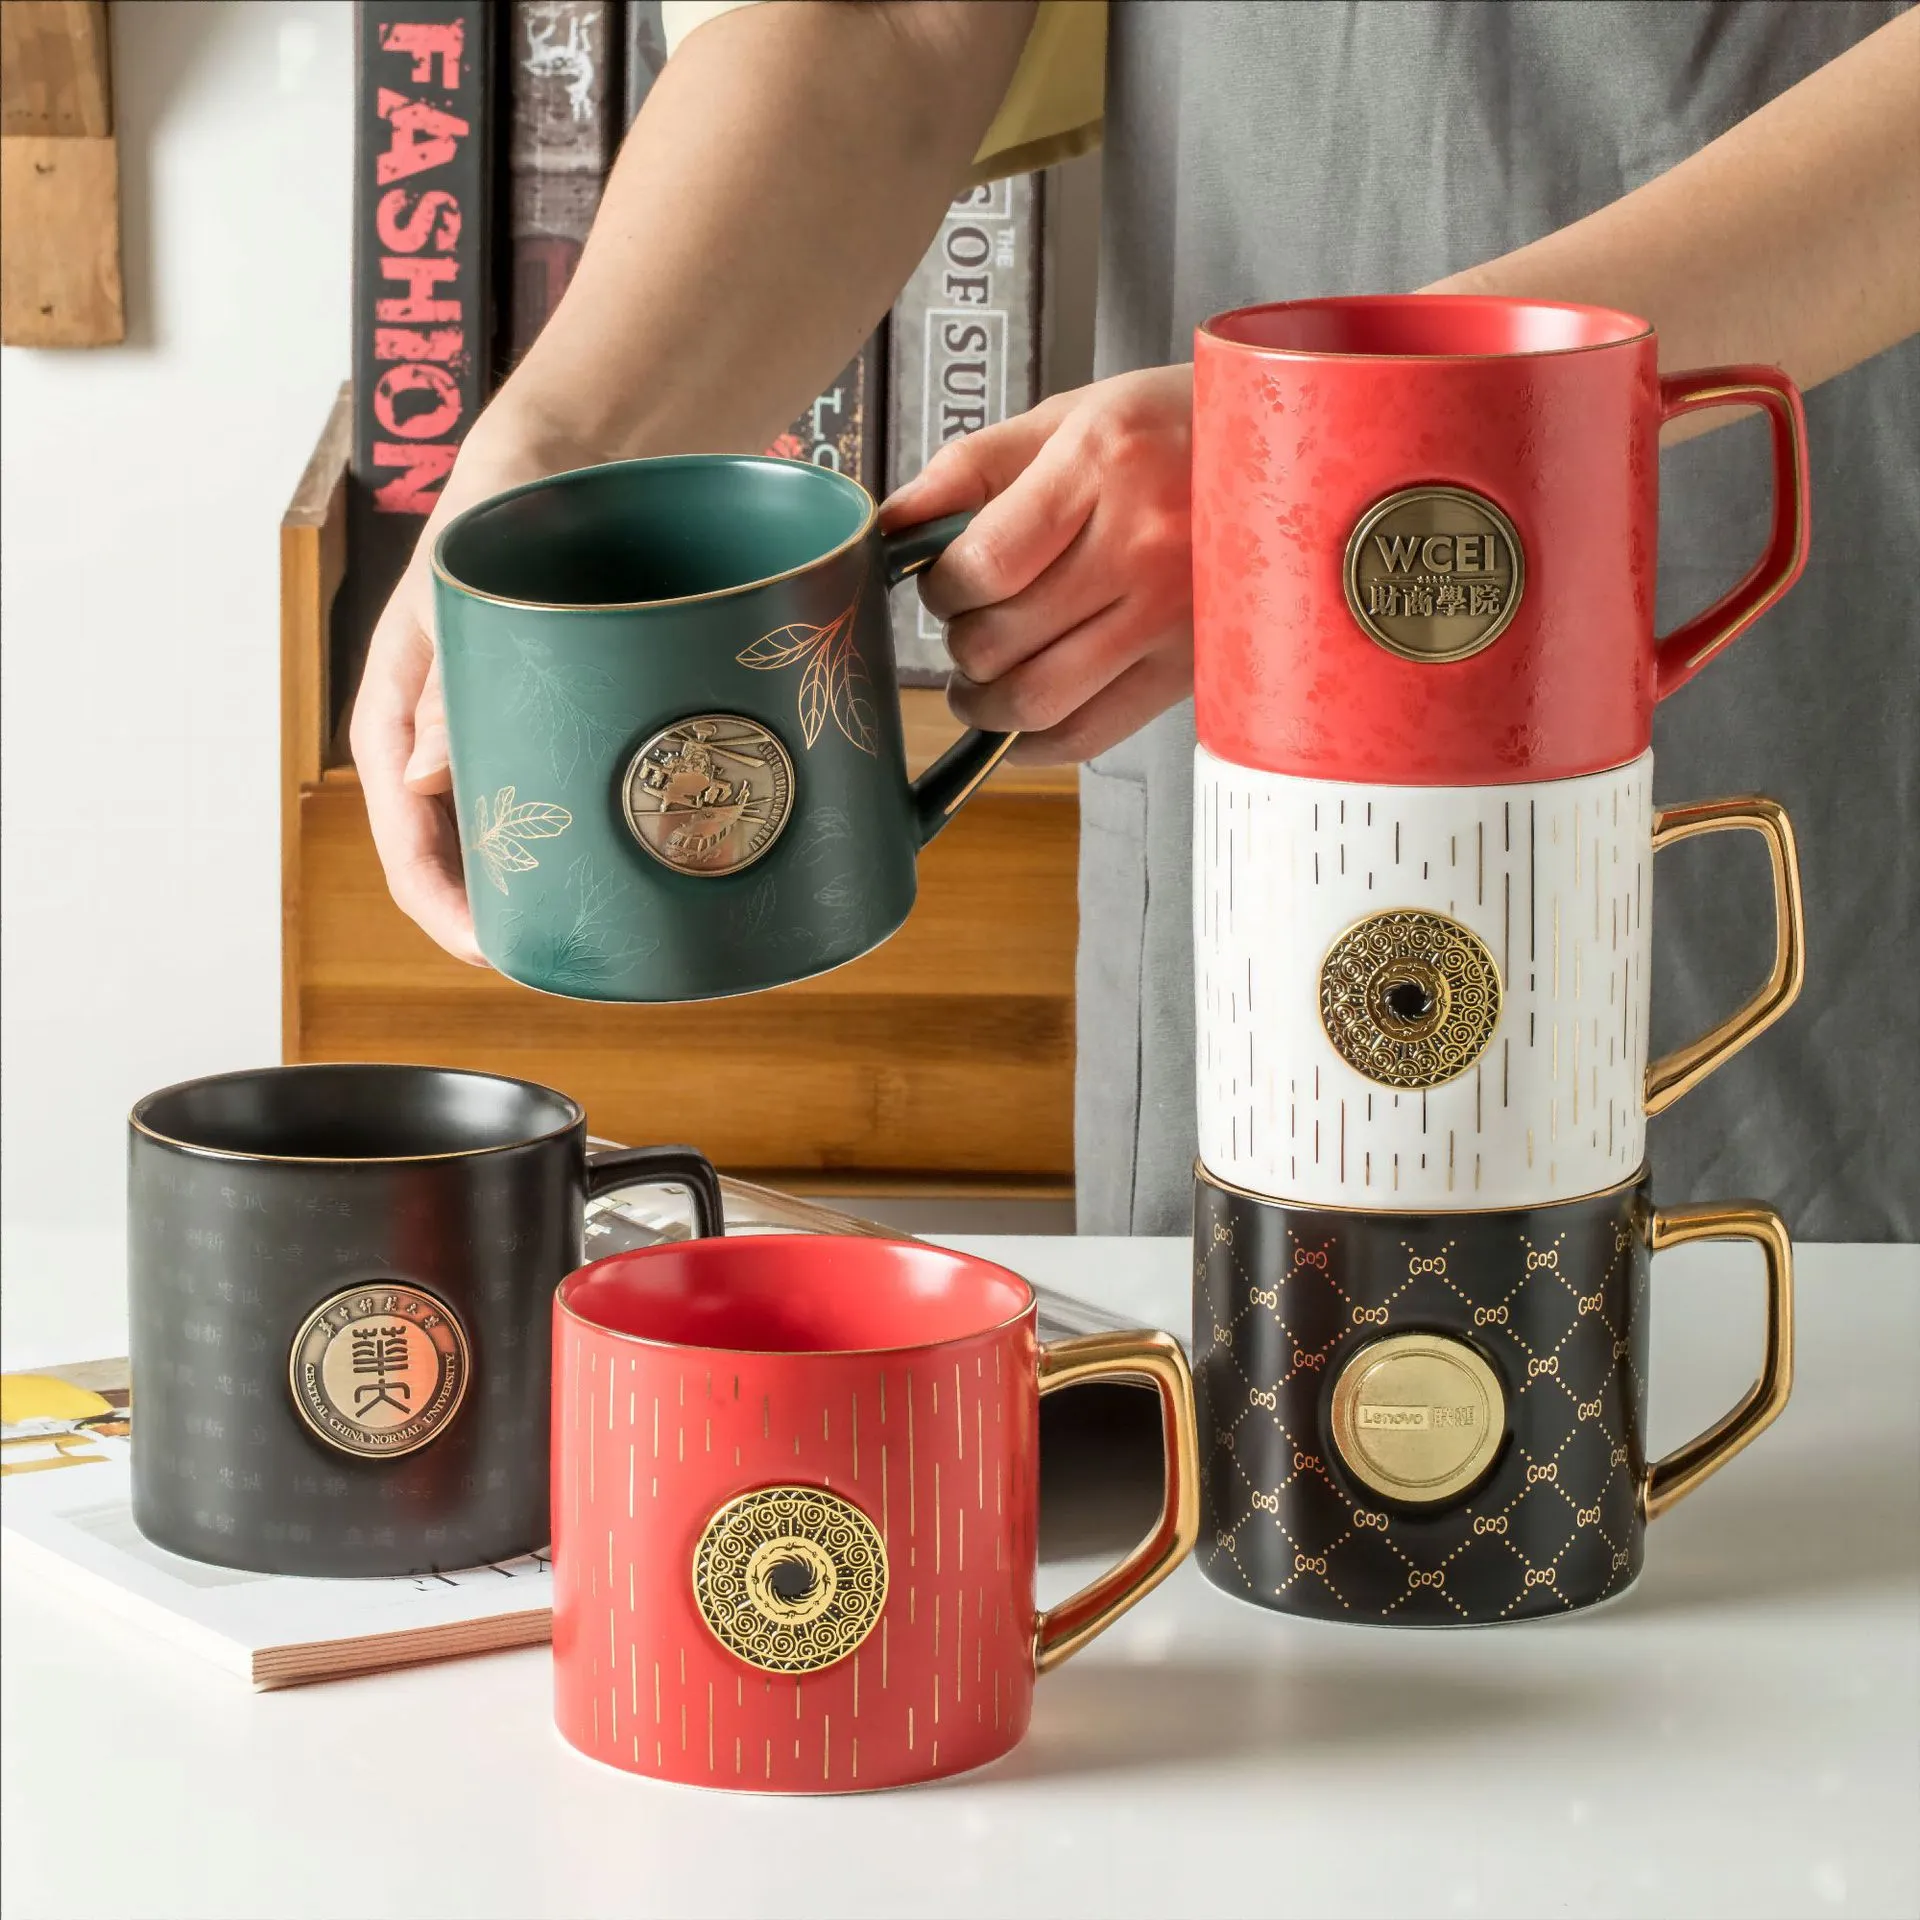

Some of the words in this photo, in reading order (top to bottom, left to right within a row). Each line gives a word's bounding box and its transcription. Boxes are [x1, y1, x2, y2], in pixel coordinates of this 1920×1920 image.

[373, 18, 469, 515] FASHION
[946, 227, 989, 304] OF
[996, 227, 1015, 268] THE
[1374, 535, 1495, 573] WCEI
[305, 1363, 328, 1419] CENTRAL
[329, 1418, 365, 1443] CHINA
[369, 1424, 423, 1445] NORMAL
[422, 1352, 455, 1424] UNIVERSITY
[1363, 1408, 1424, 1425] Lenovo
